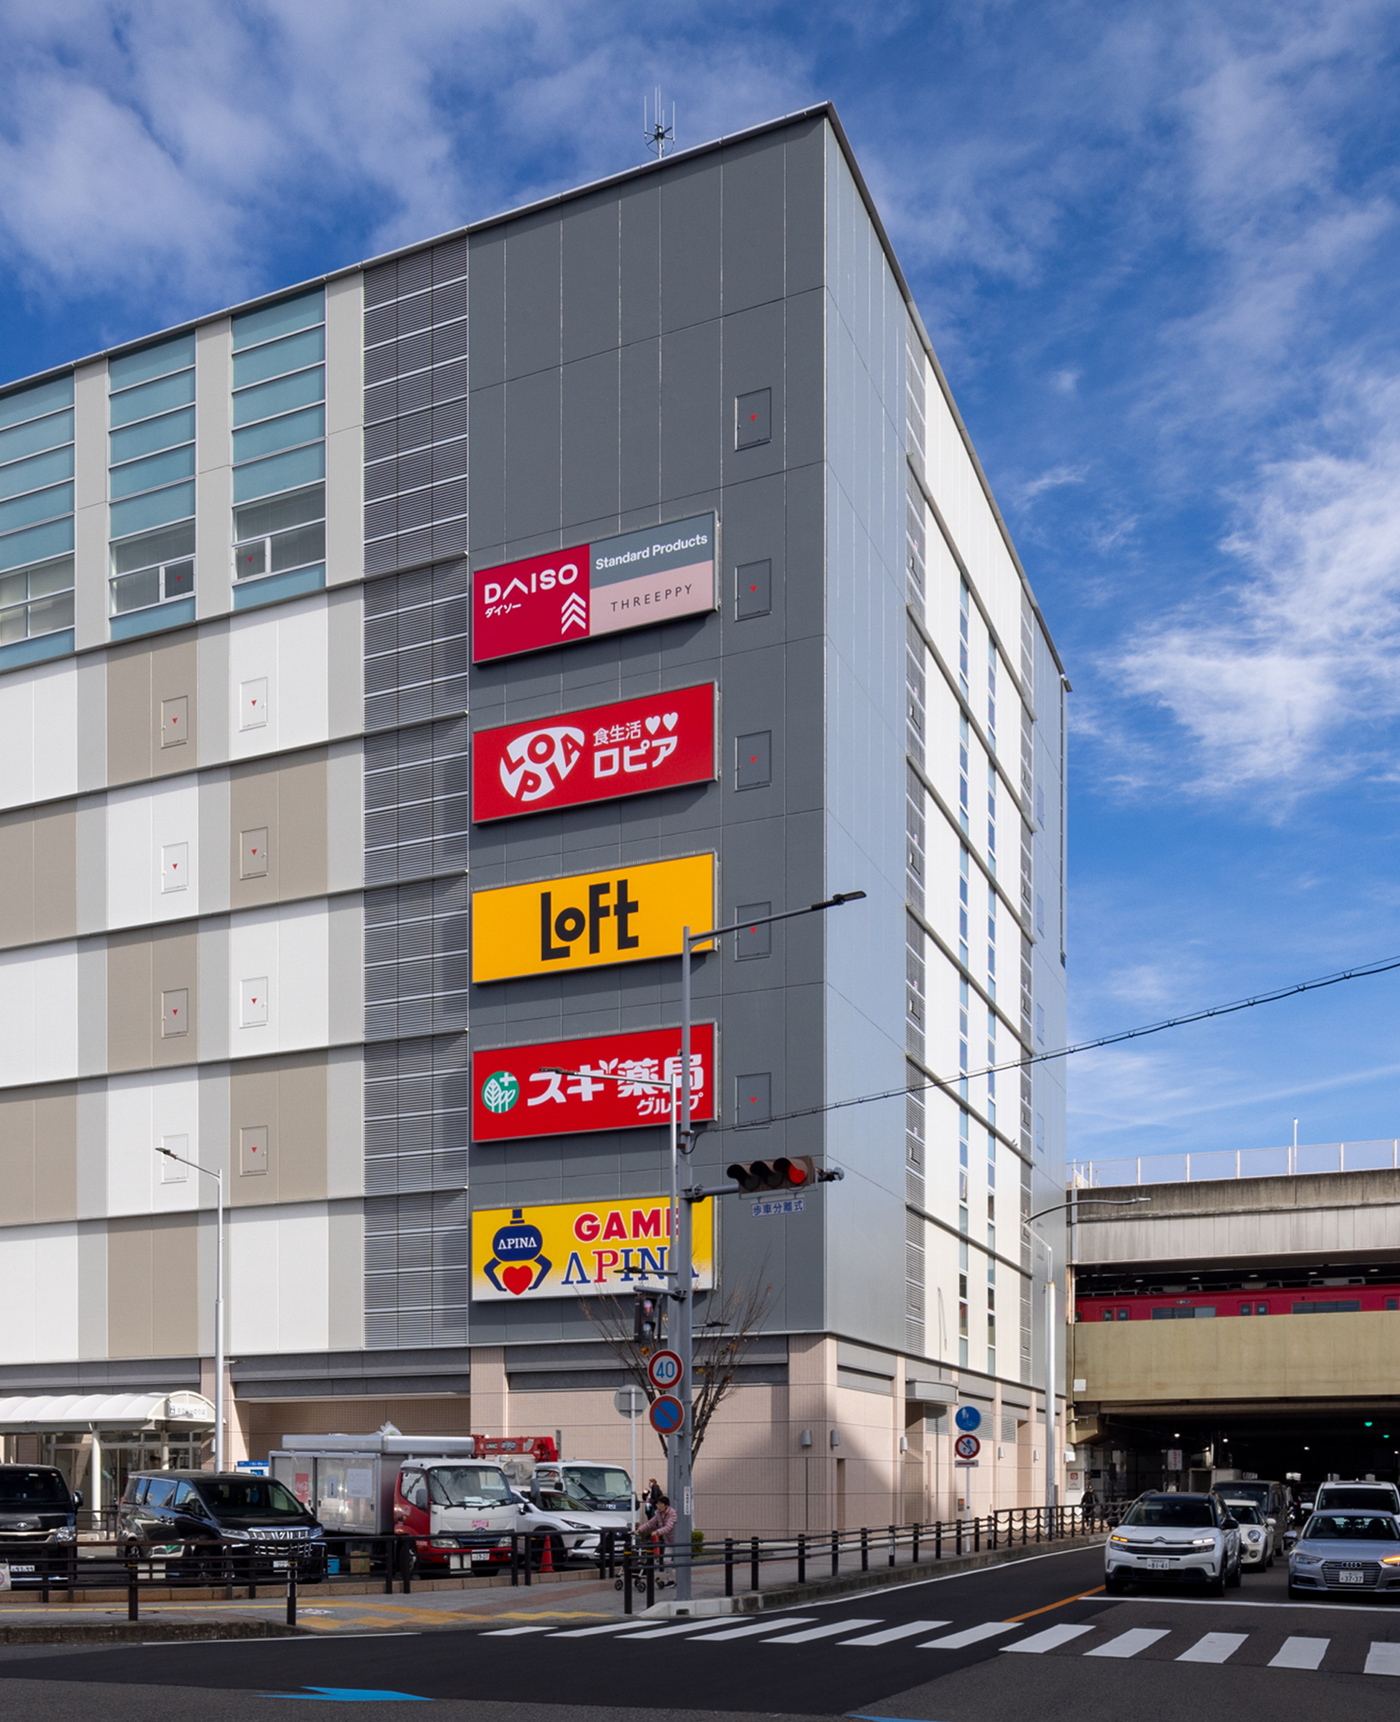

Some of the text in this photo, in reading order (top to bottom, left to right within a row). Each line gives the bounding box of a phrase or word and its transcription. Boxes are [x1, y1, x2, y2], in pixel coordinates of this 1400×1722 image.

[595, 533, 709, 571] Standard Products
[484, 563, 578, 604] DAISO
[610, 583, 693, 612] THREEPPY
[484, 602, 522, 618] ダイソー
[593, 719, 642, 747] 食生活
[594, 735, 678, 778] ロピア
[527, 1054, 704, 1106] スギ薬局
[752, 1200, 804, 1217] 歩車分離式
[498, 1236, 537, 1250] APINA
[656, 1361, 675, 1379] 40
